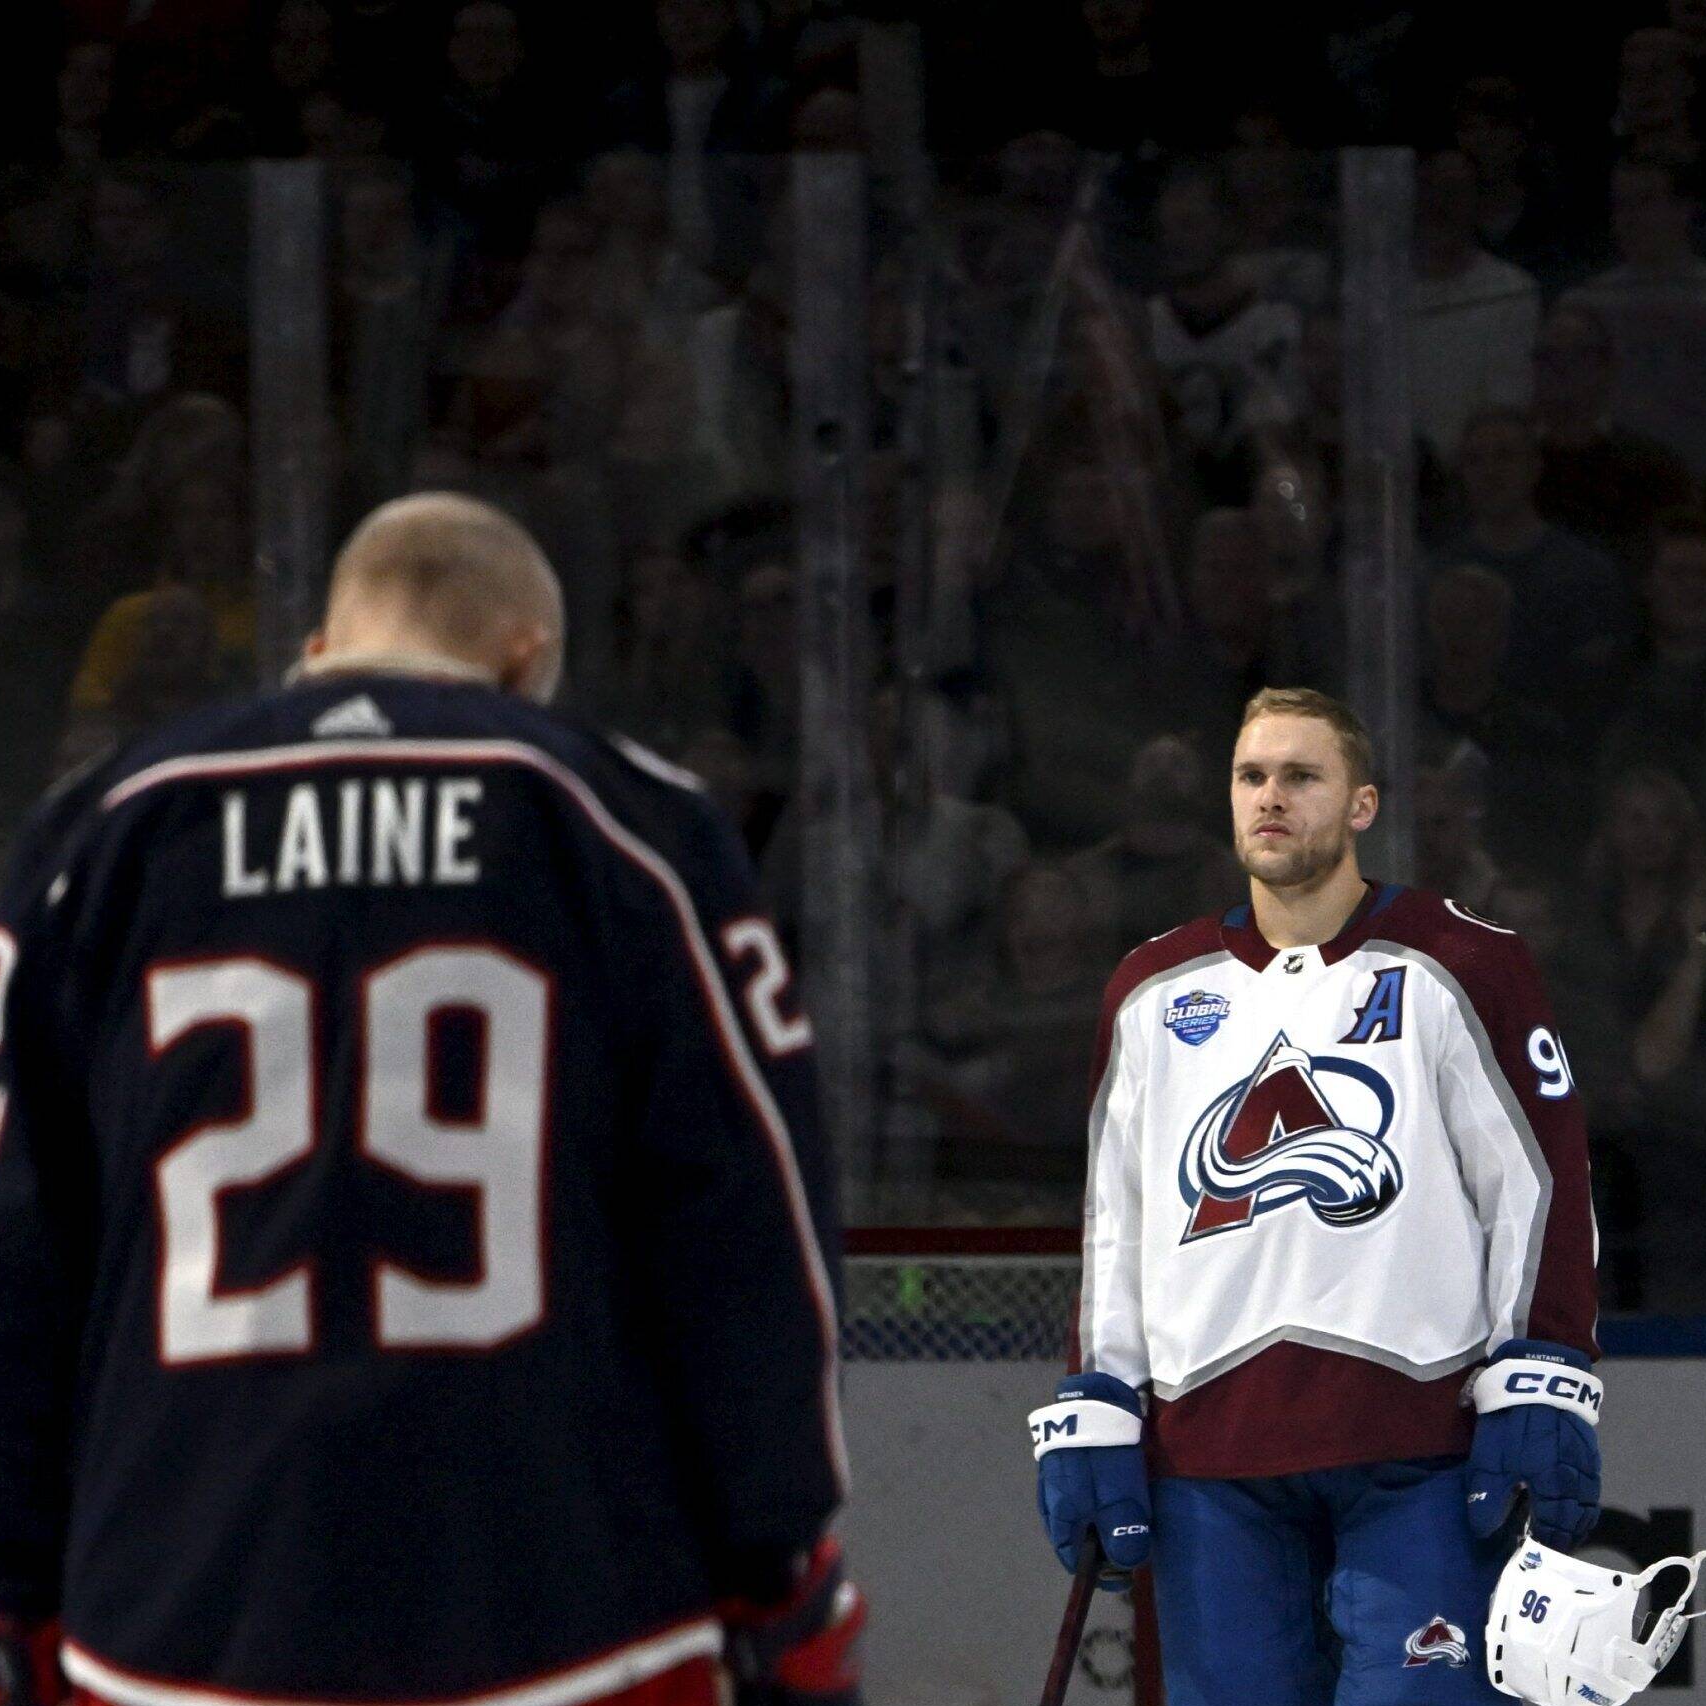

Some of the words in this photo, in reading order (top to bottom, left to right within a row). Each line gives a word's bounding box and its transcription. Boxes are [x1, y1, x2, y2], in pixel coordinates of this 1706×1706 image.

[221, 775, 484, 899] LAINE
[1165, 1000, 1230, 1024] GLOBAL
[1173, 1015, 1218, 1030] SERIES
[1337, 965, 1407, 1043] A
[1528, 1024, 1575, 1100] 9
[146, 940, 555, 1369] 29
[1504, 1371, 1602, 1412] CCM
[1518, 1589, 1551, 1624] 96
